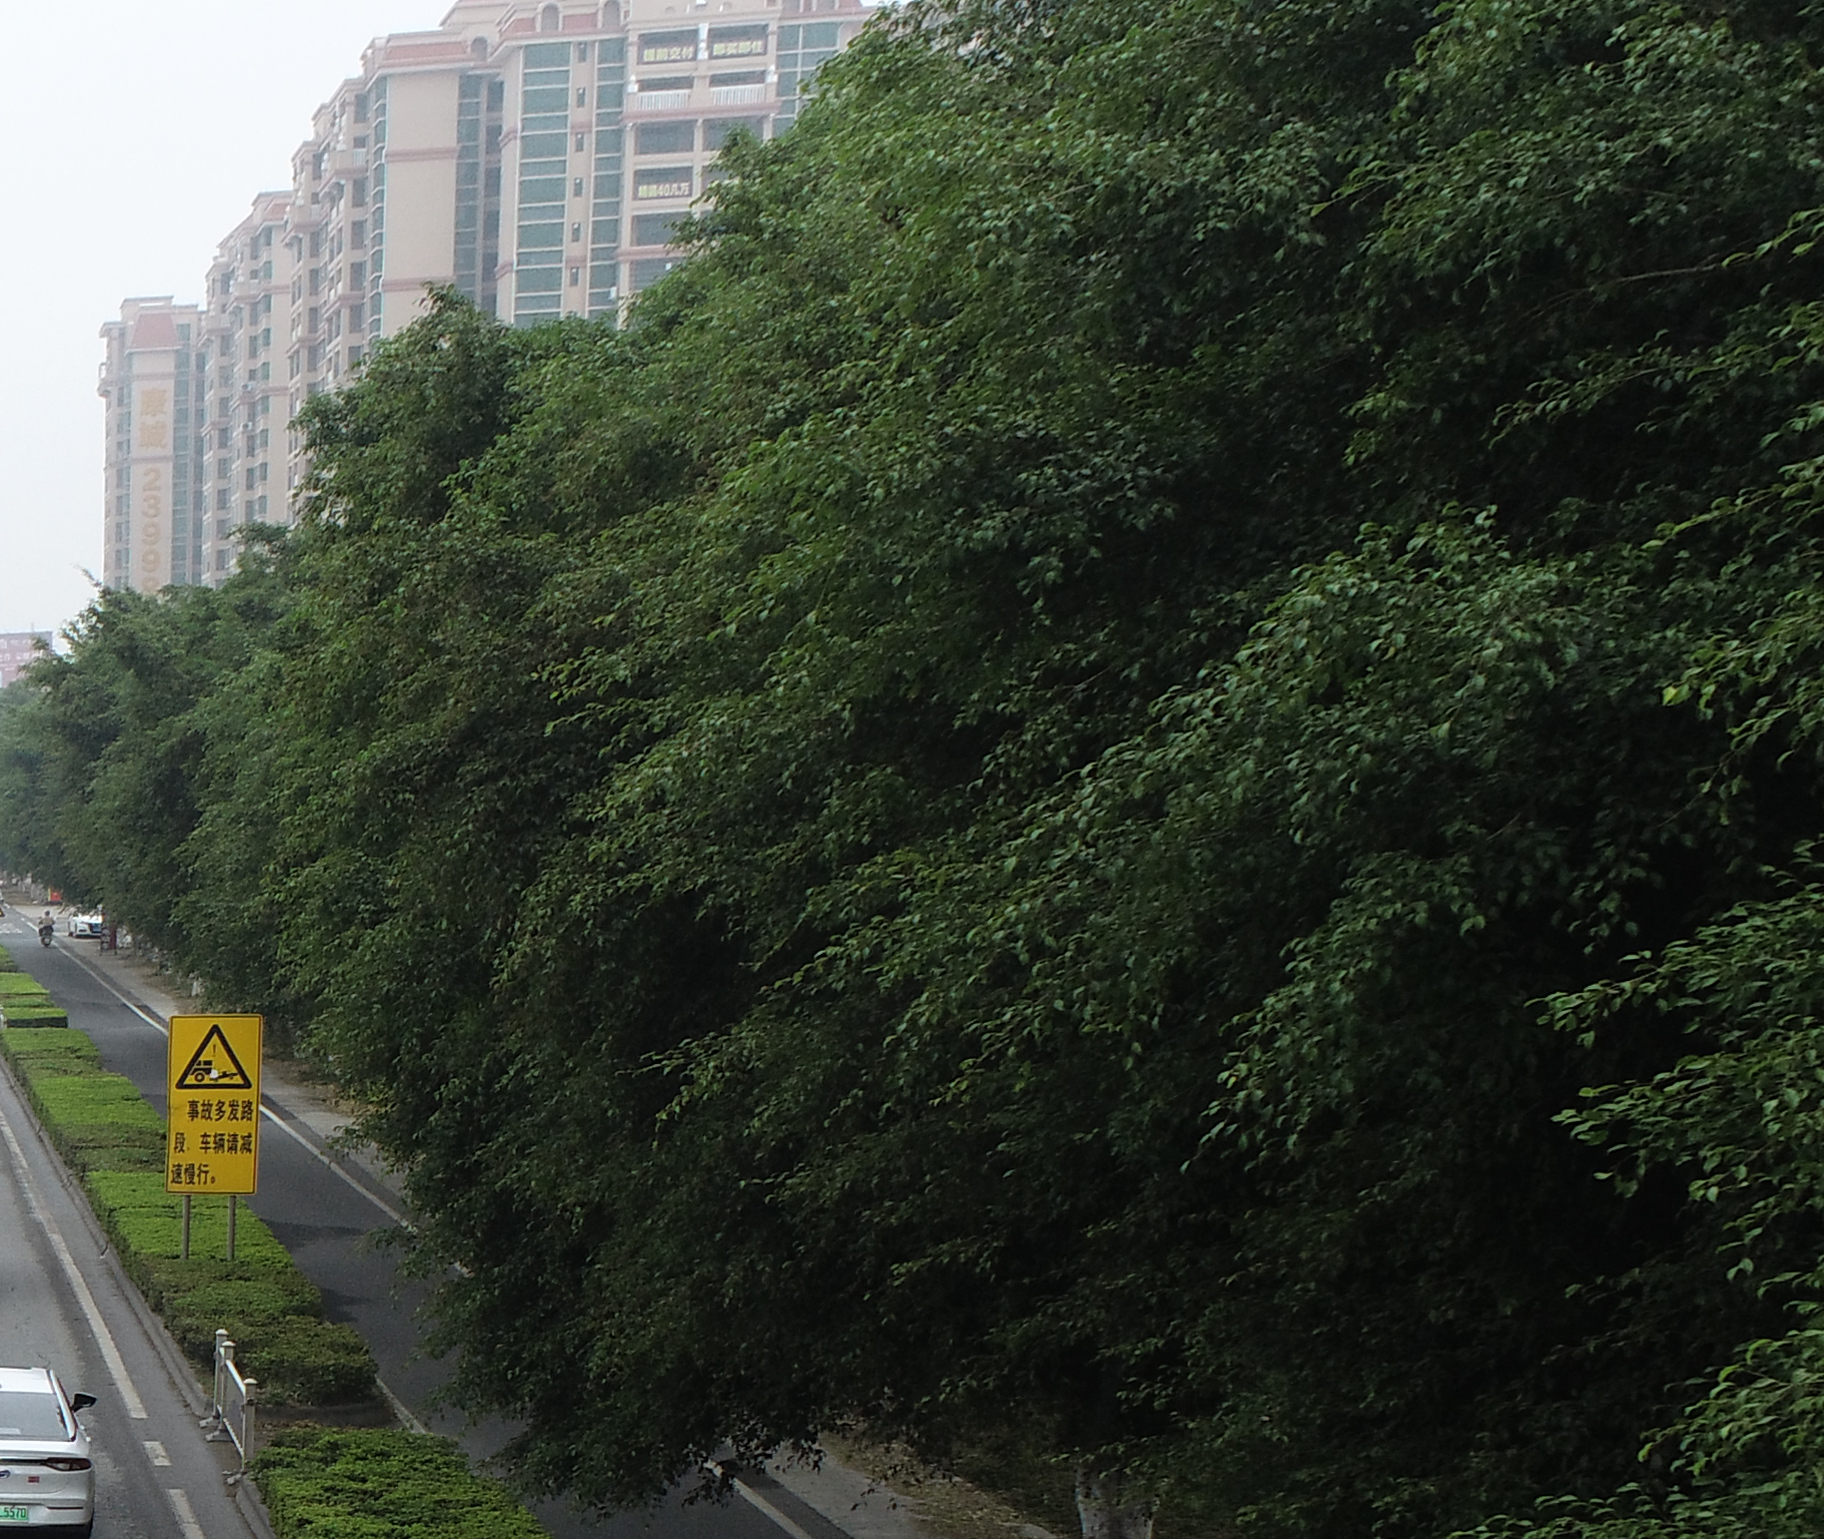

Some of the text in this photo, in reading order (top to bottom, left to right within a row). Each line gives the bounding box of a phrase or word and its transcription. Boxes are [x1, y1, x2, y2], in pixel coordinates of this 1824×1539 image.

[187, 1100, 254, 1122] 事故多发路
